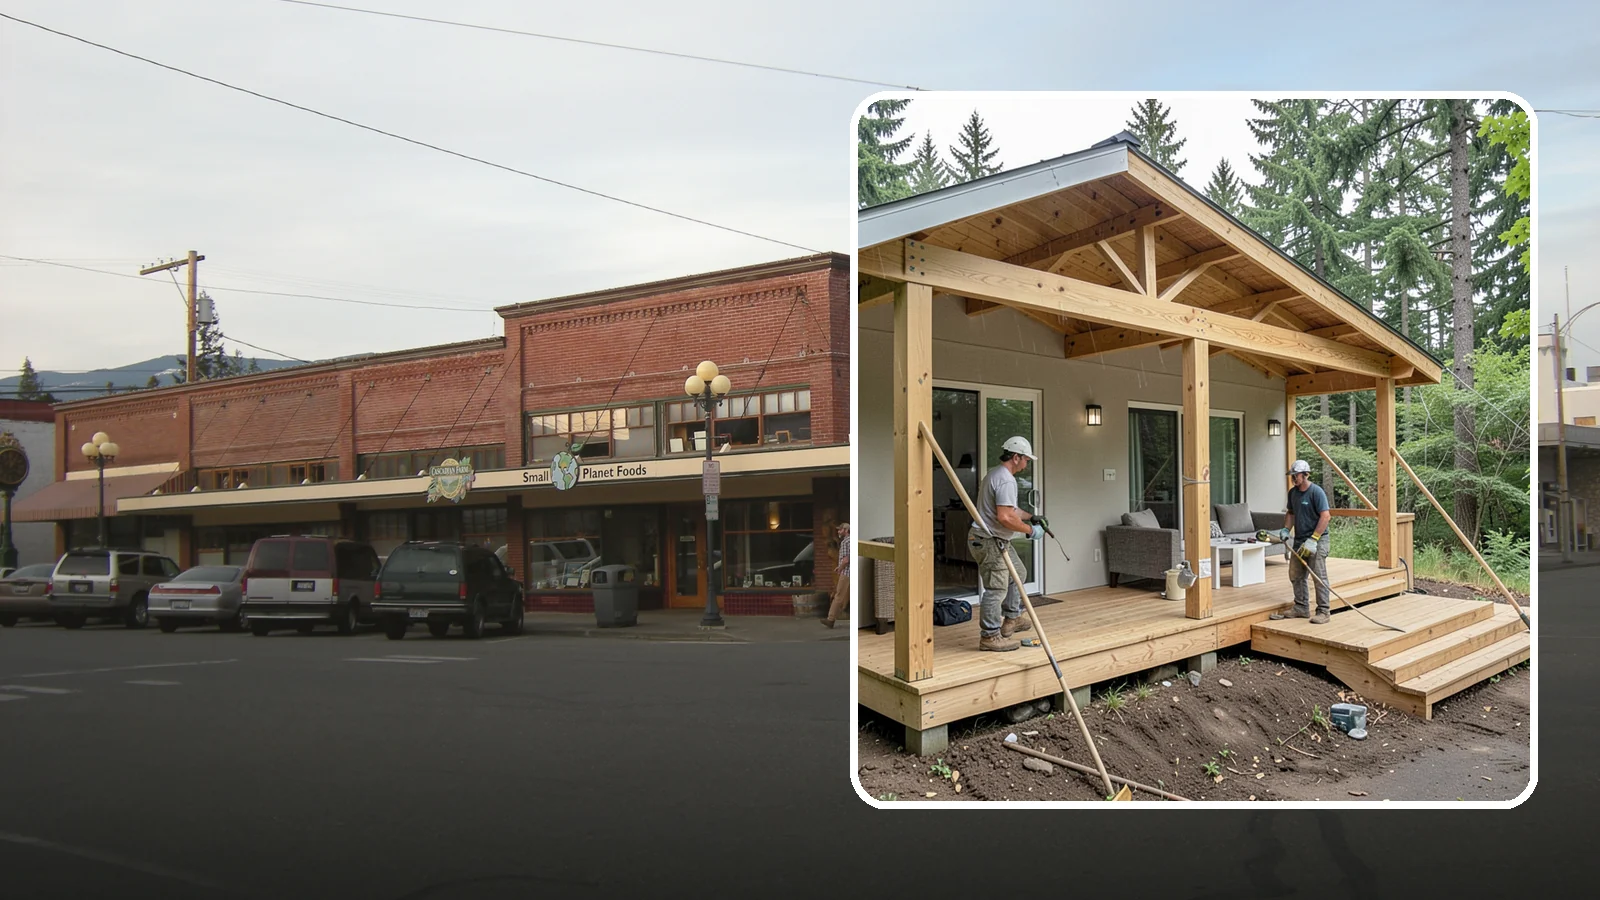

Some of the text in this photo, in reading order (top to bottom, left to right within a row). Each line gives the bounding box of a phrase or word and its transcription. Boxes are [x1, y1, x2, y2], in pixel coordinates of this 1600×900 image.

[522, 464, 647, 483] Small Planet Foods
